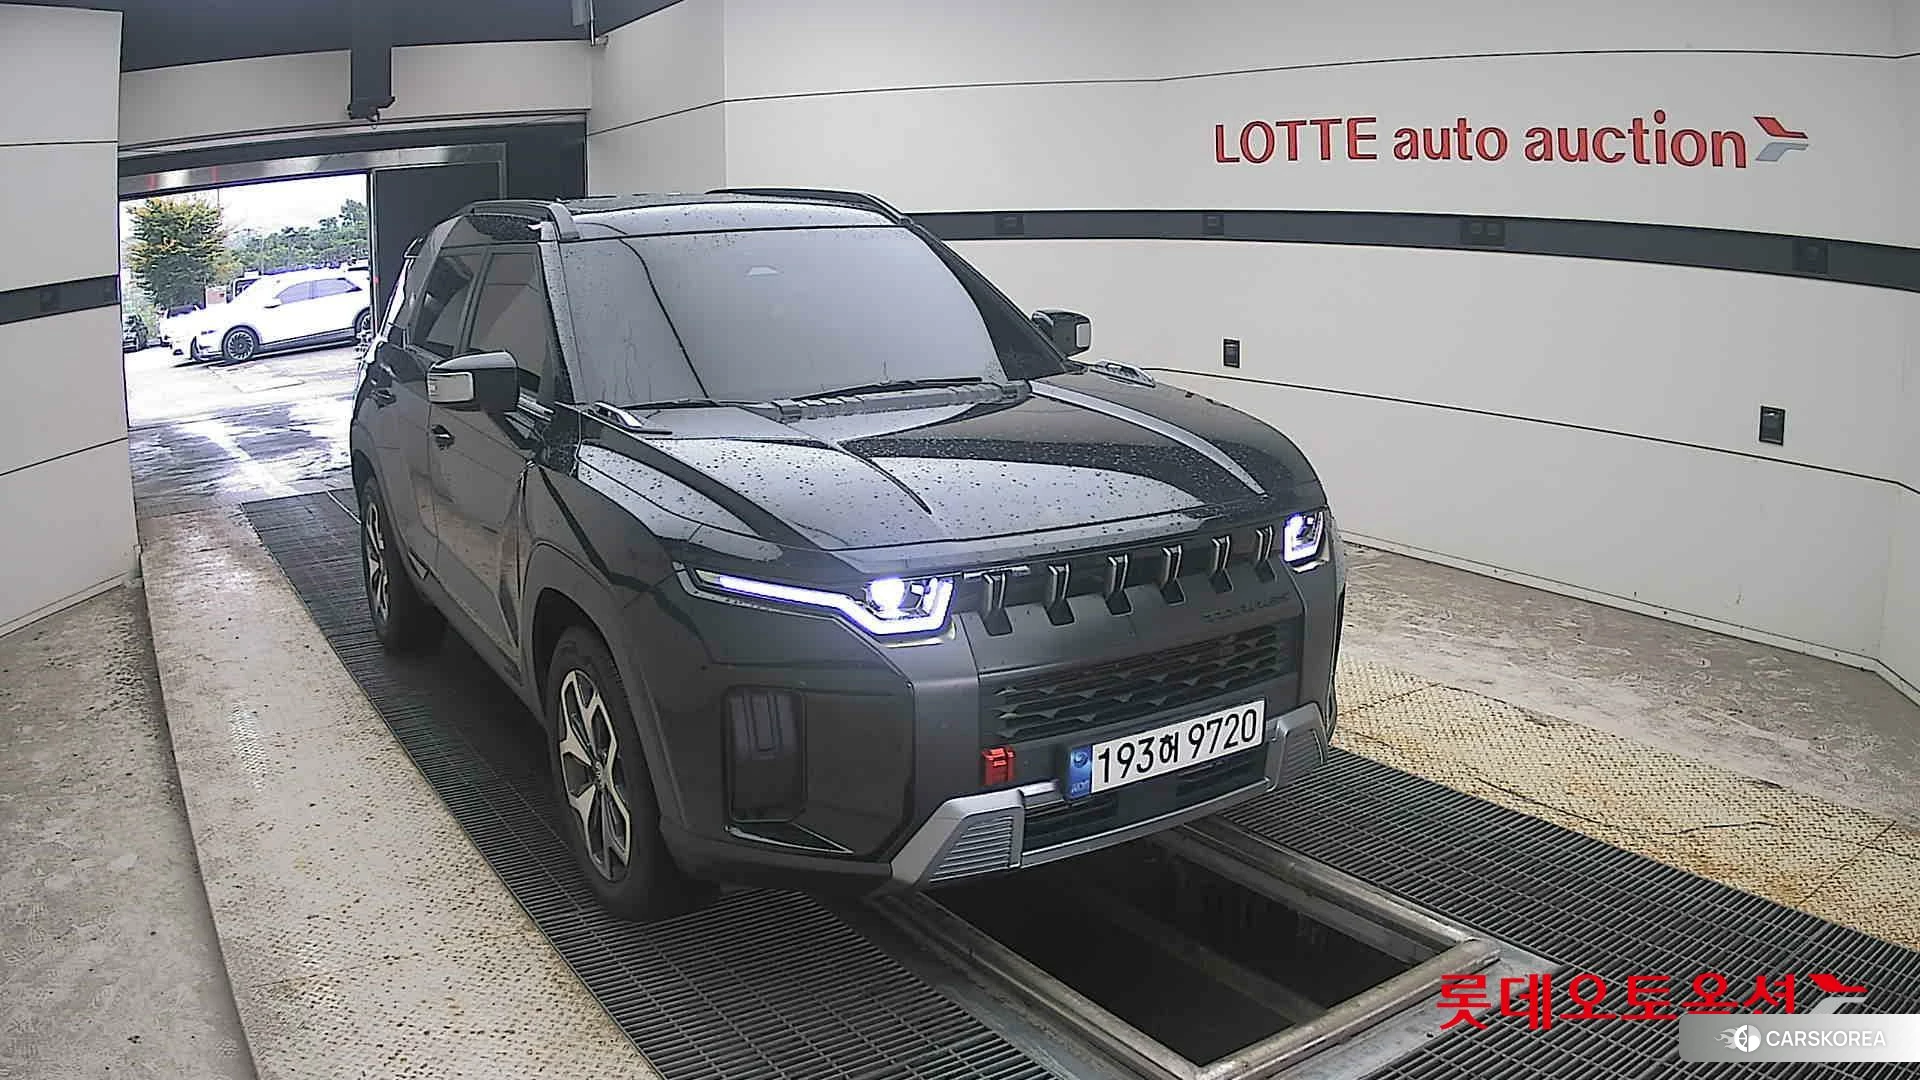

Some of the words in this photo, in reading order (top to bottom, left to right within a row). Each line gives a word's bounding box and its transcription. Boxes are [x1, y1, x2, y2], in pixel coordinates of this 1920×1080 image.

[1215, 116, 1378, 164] LOTTE
[1392, 117, 1508, 162] auto
[1524, 110, 1747, 168] auction
[1098, 731, 1180, 784] 193허
[1188, 709, 1257, 759] 9720
